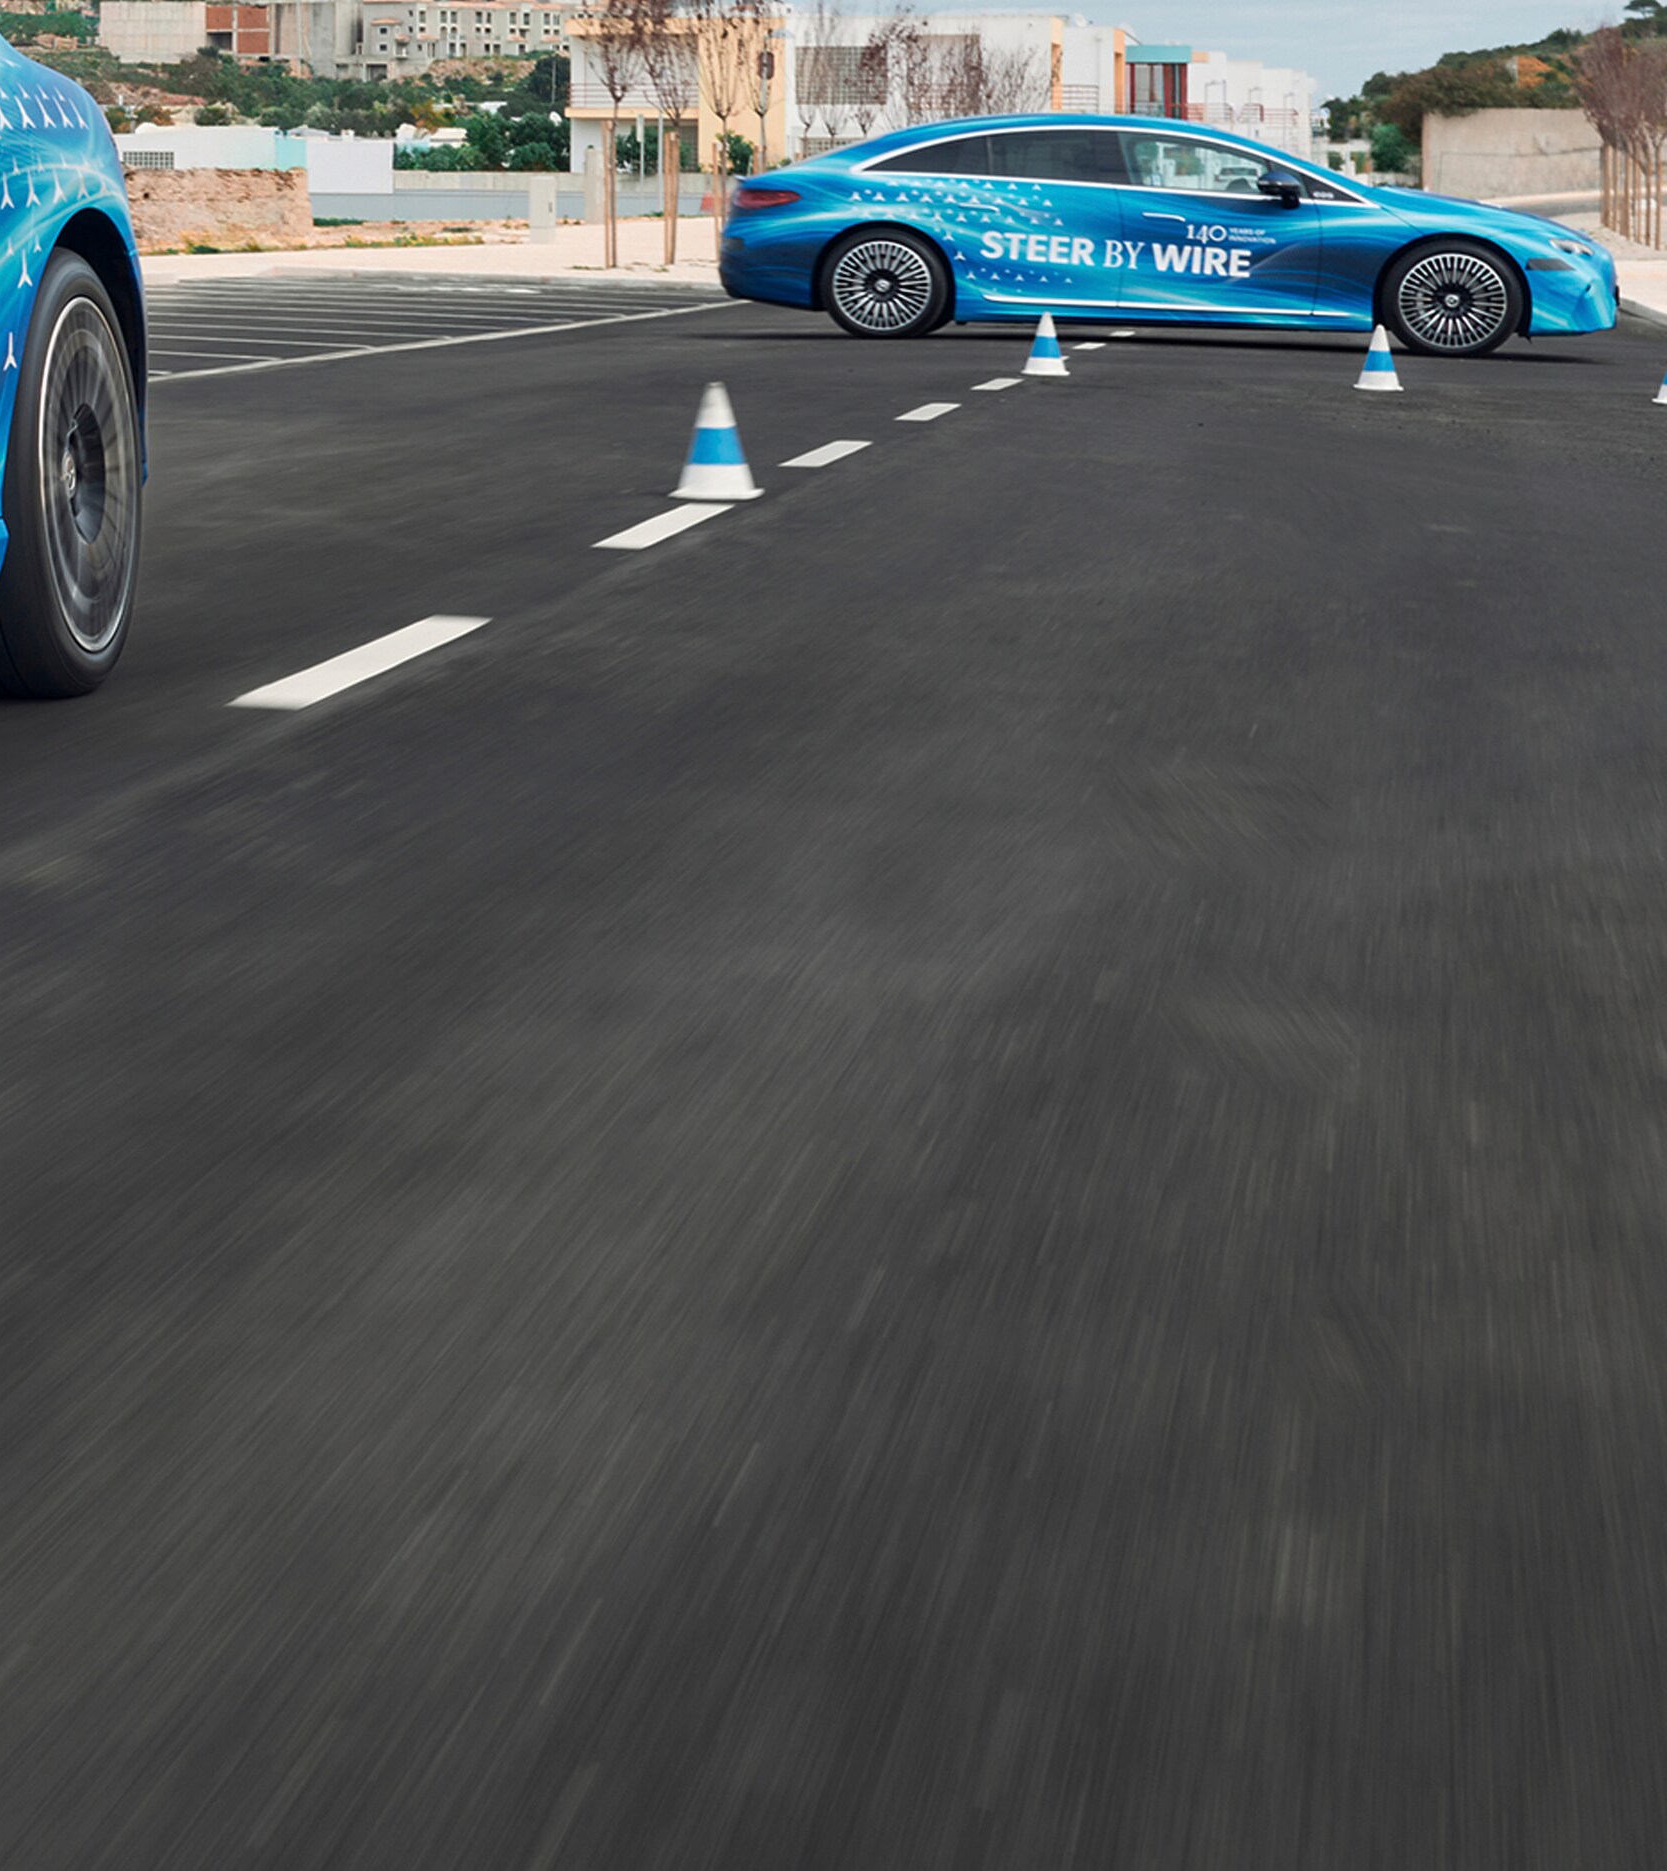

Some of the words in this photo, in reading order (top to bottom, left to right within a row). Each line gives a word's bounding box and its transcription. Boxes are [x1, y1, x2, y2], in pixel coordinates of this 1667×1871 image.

[1186, 224, 1227, 244] 140
[980, 231, 1095, 267] STEER
[1103, 239, 1146, 270] BY
[1153, 244, 1251, 278] WIRE
